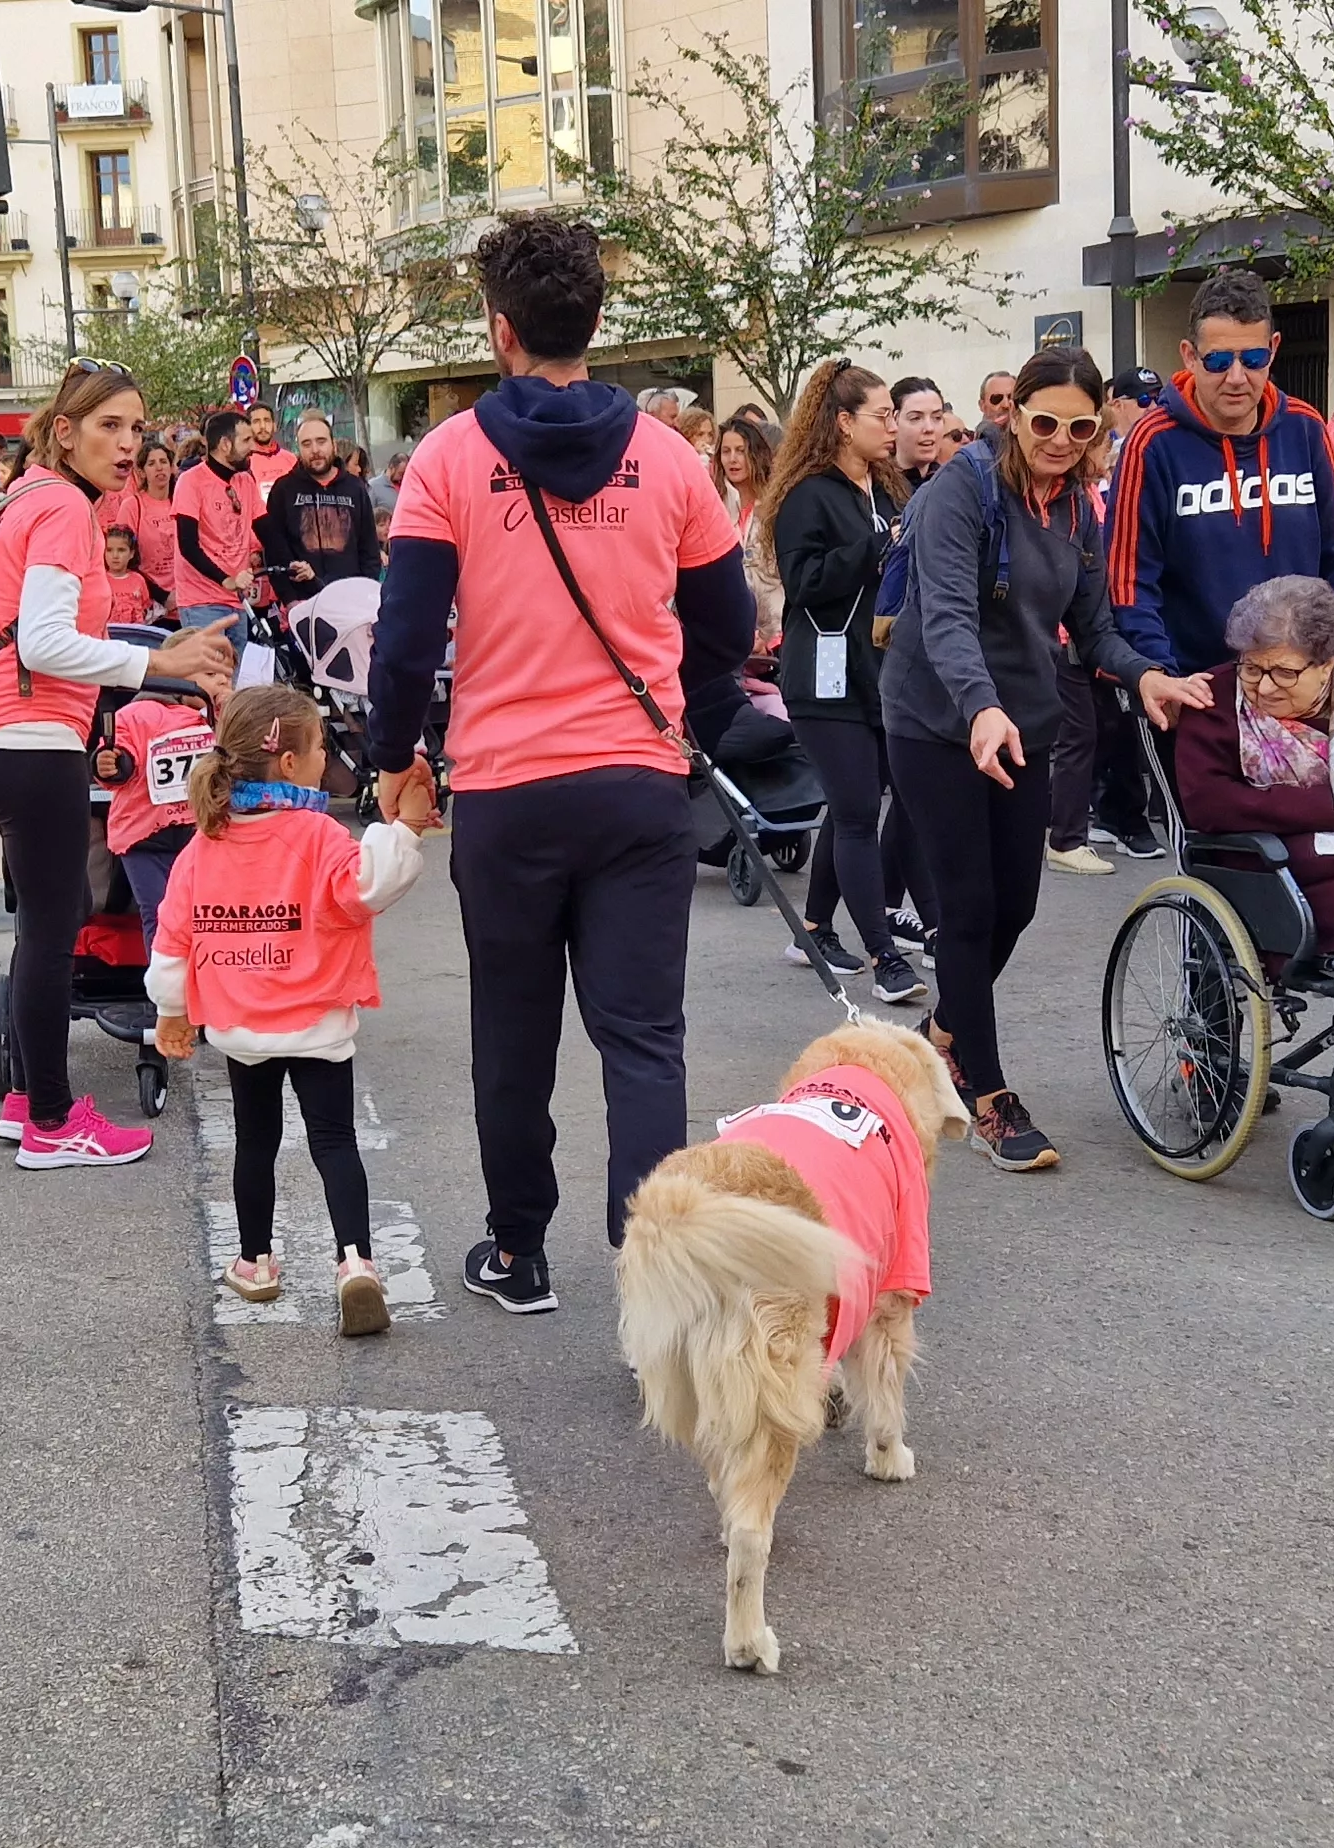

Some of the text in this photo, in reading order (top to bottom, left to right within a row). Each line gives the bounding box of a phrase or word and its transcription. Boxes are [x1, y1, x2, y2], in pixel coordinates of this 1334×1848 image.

[1176, 468, 1317, 516] adidas
[548, 498, 630, 525] astellar
[156, 753, 208, 785] 37
[192, 920, 289, 932] SUPERMERCADOS
[211, 942, 295, 966] castellar
